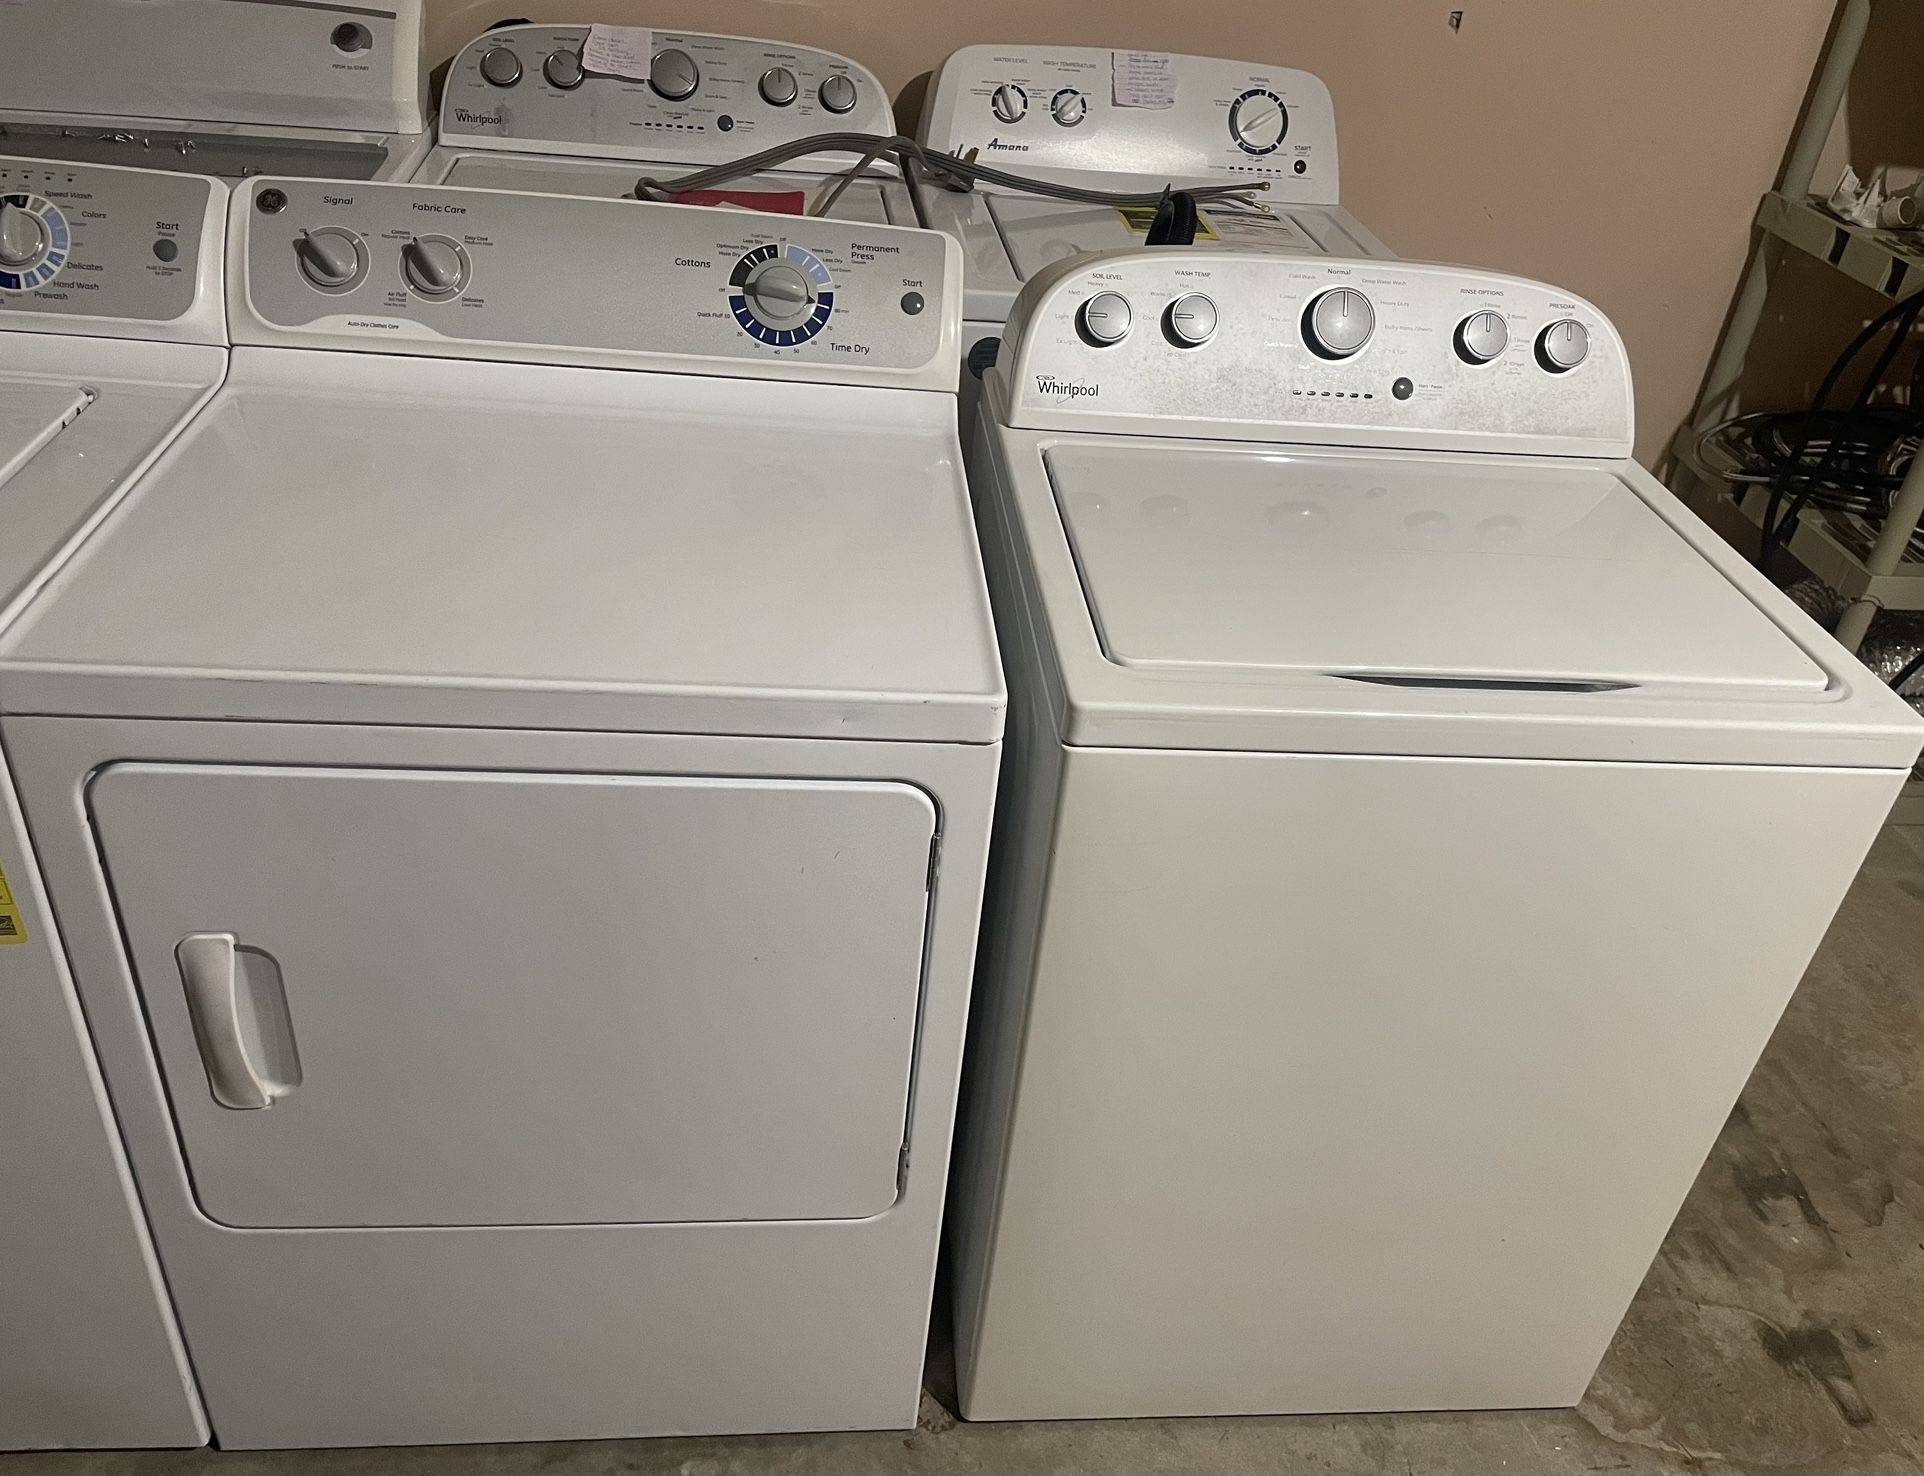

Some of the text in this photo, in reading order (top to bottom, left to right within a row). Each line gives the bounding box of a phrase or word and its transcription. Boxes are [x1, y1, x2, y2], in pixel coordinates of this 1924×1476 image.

[456, 112, 502, 127] Whirlpool
[987, 138, 1030, 152] Amana
[45, 190, 69, 199] Speed
[323, 195, 353, 206] Signal
[412, 203, 467, 215] Fabric Care
[82, 211, 107, 219] Colors
[156, 221, 180, 231] Start
[851, 243, 901, 254] Permanent
[851, 252, 875, 261] Press
[67, 262, 104, 272] Delicates
[675, 258, 711, 268] Cottons
[1092, 272, 1123, 281] SOIL LEVEL
[1328, 268, 1352, 276] Normal
[53, 280, 100, 291] Hand Wash
[902, 279, 923, 288] Start
[34, 291, 68, 301] Prewash
[348, 321, 369, 329] Auto-Dry
[830, 343, 870, 355] Time Dry
[1038, 380, 1099, 400] Whirlpool
